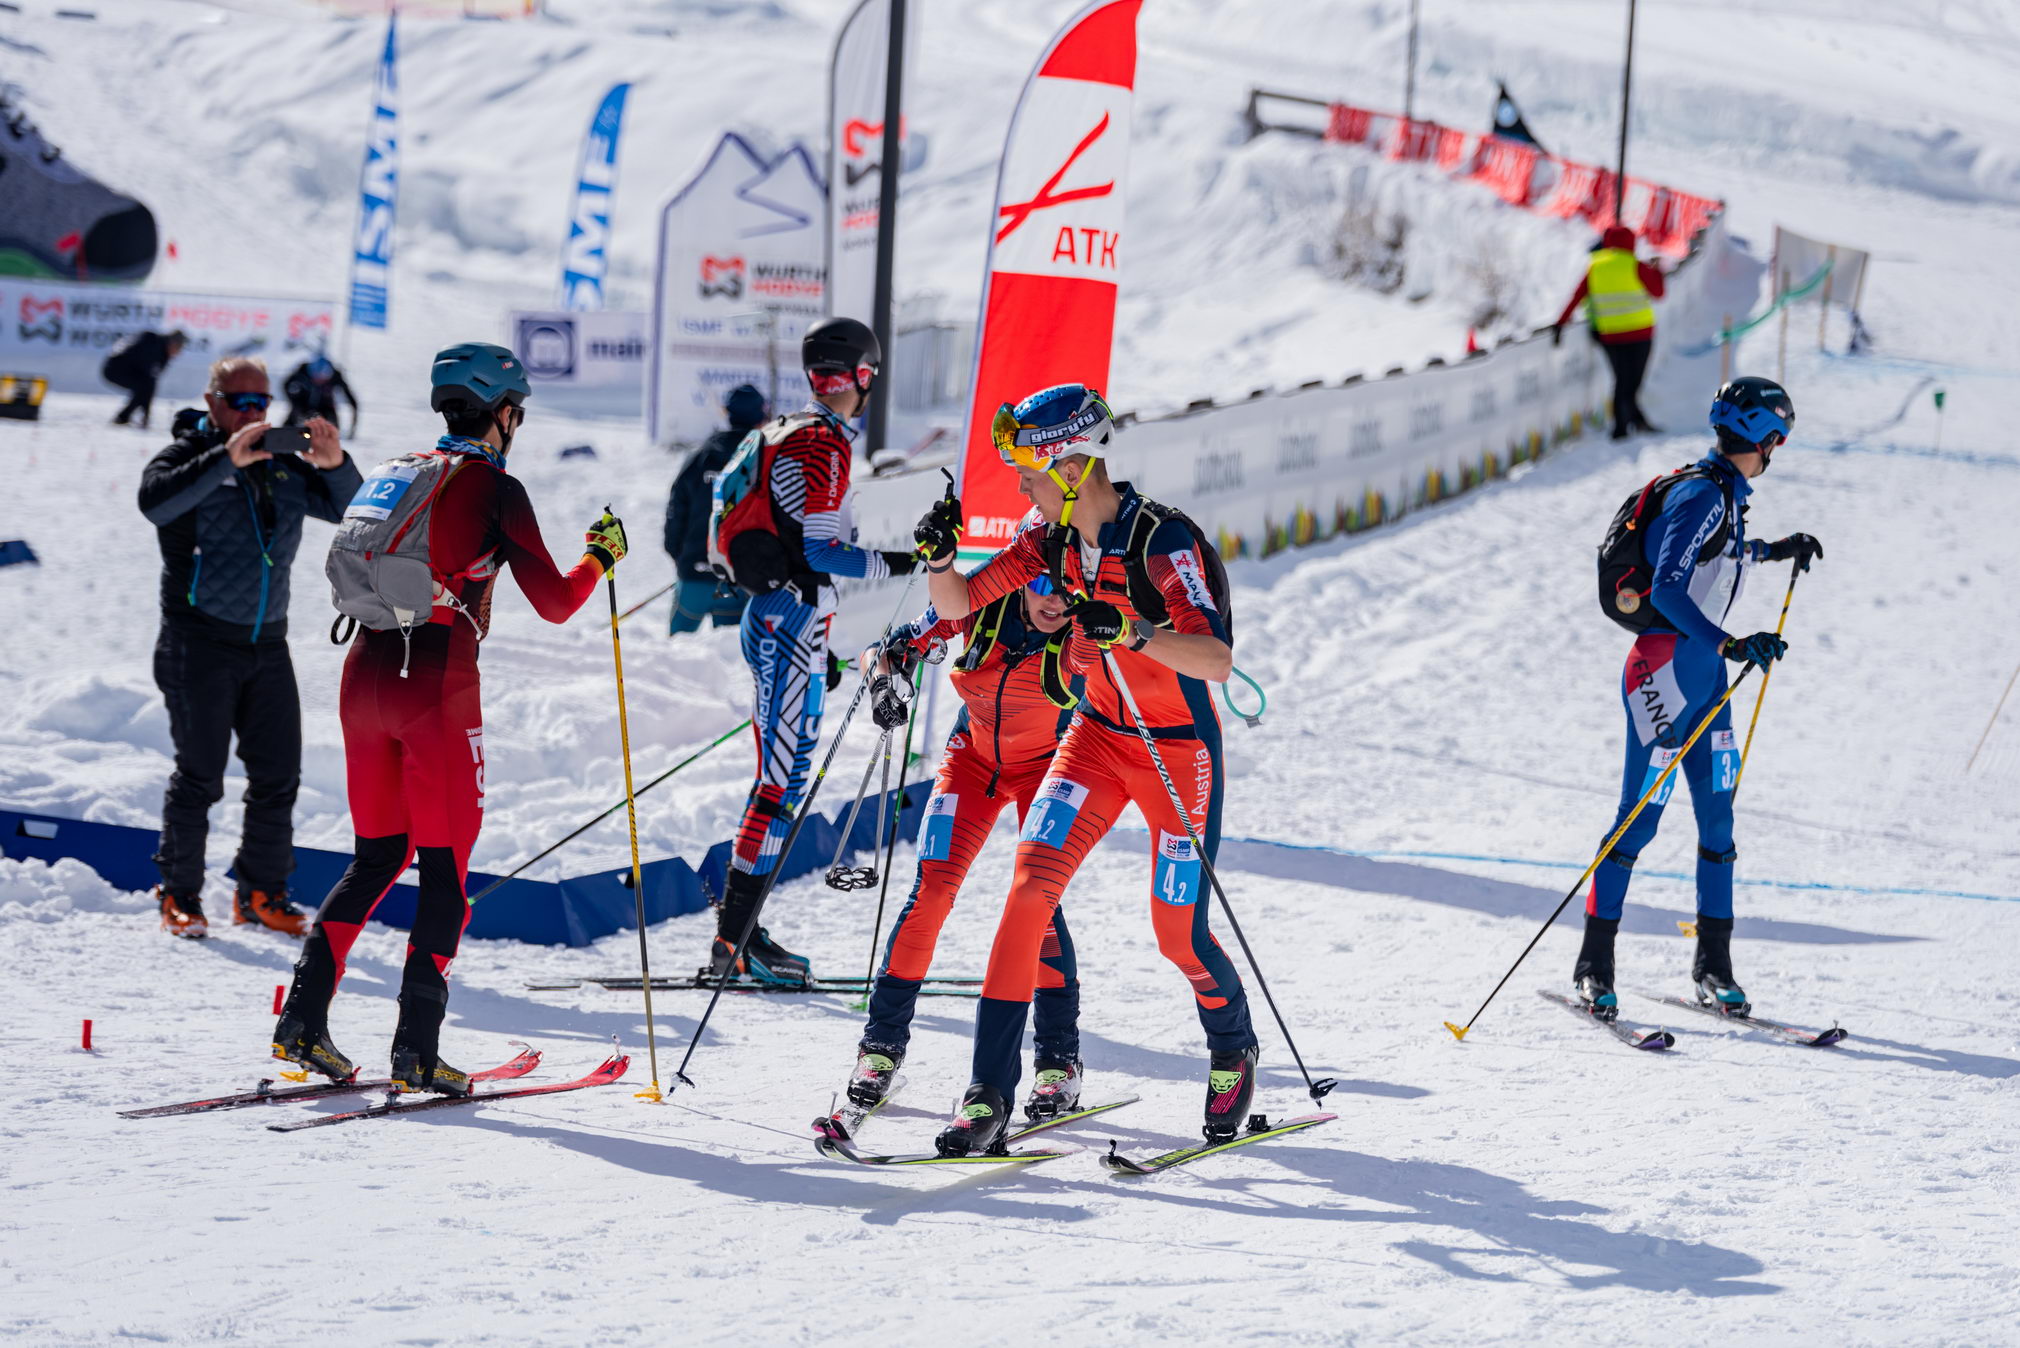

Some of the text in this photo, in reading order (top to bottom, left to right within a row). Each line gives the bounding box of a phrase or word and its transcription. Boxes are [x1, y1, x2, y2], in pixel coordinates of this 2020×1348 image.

[1052, 226, 1119, 269] ATK
[1031, 412, 1096, 443] gloryfy
[365, 481, 396, 500] 1.2
[828, 451, 840, 498] DAVORIN
[593, 534, 624, 562] LEKI
[760, 638, 777, 739] DAVORIN
[1632, 659, 1678, 748] FRANCE
[1132, 711, 1179, 797] DYNAFIT
[1192, 748, 1210, 815] Austria
[1028, 800, 1056, 841] 4.2
[1162, 861, 1188, 903] 4.2
